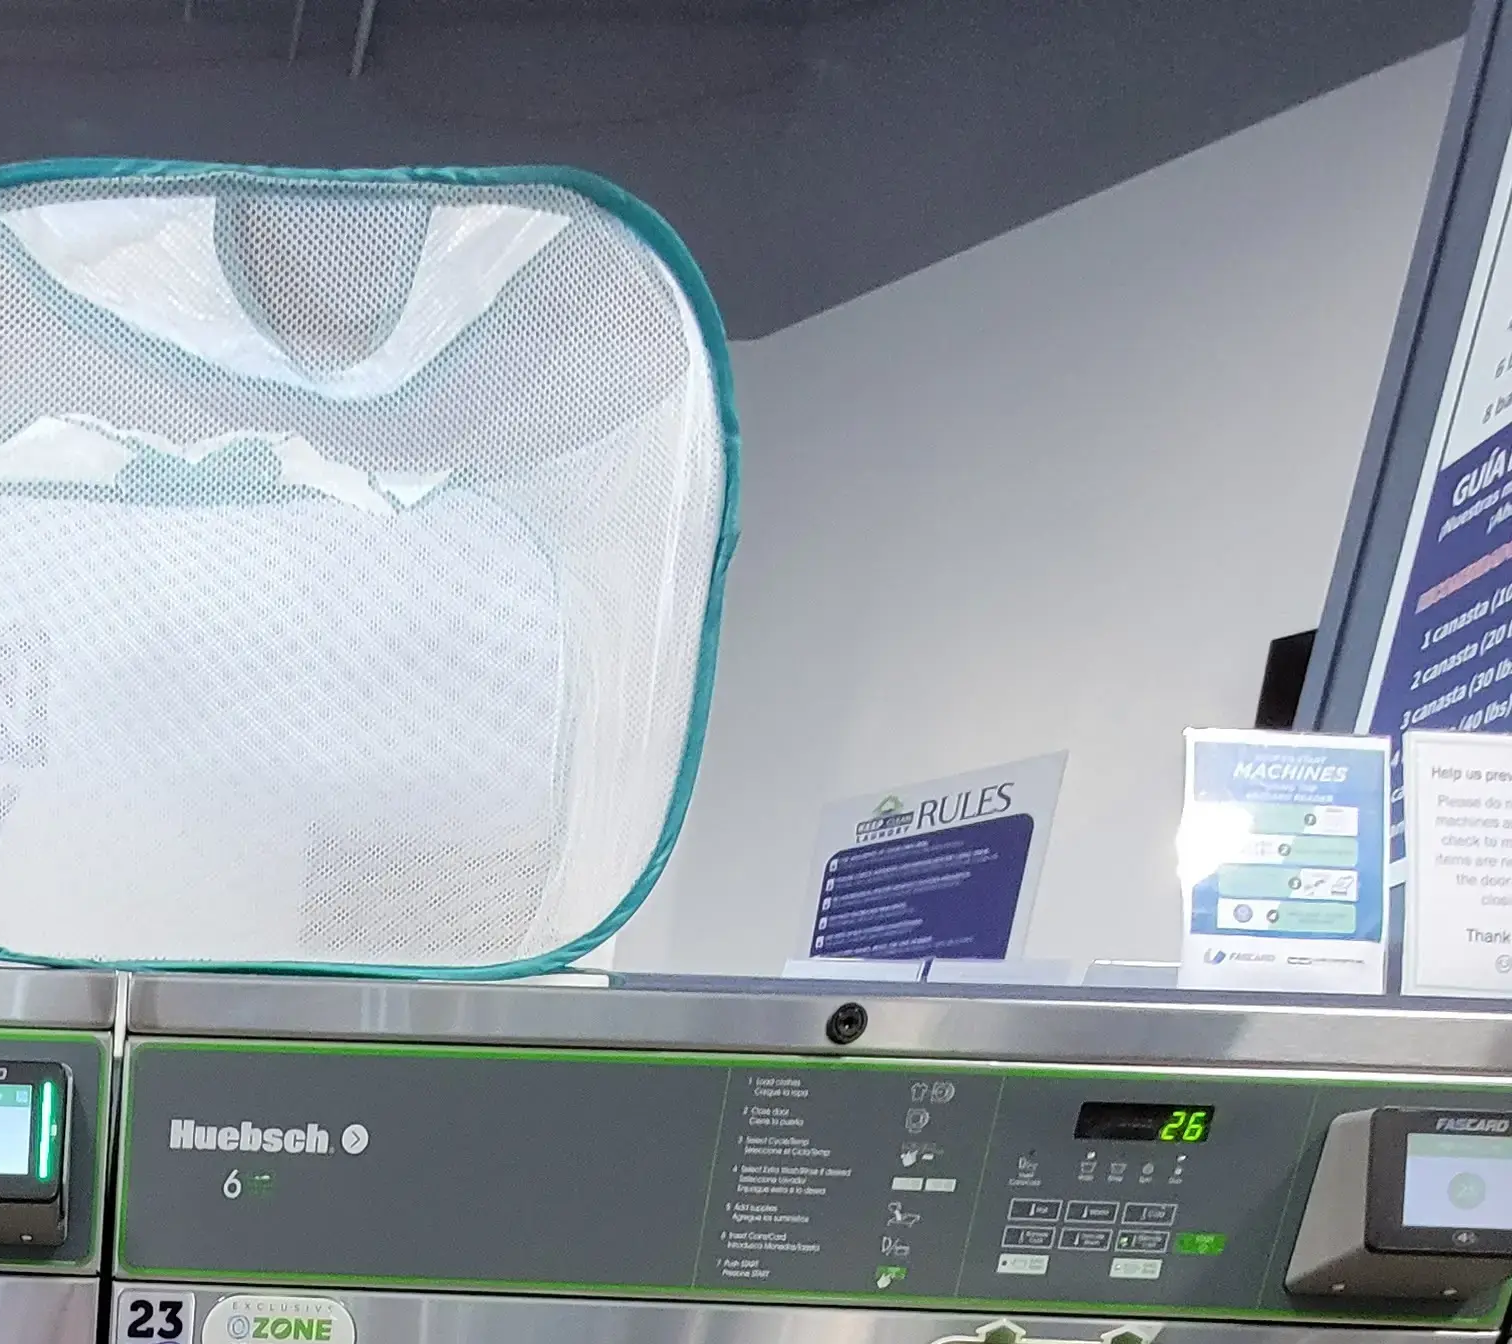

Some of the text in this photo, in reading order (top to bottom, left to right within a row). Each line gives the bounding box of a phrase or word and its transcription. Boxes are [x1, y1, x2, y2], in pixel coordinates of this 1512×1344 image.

[1452, 446, 1506, 507] GUÍA
[1421, 630, 1432, 650] 1
[1432, 600, 1489, 642] canasta
[1410, 629, 1505, 691] 2 canasta (20
[1400, 711, 1411, 730] 3
[1412, 683, 1467, 724] canasta
[1468, 666, 1495, 699] (30
[1233, 762, 1349, 783] MACHINES
[1431, 766, 1462, 781] Help
[1466, 769, 1482, 780] us
[917, 782, 1014, 829] RULES
[1438, 794, 1503, 809] Please do
[1441, 834, 1482, 848] check
[1456, 873, 1478, 886] the
[1466, 928, 1511, 944] Thank
[169, 1119, 330, 1154] Huebsch
[1159, 1111, 1207, 1141] 26
[1436, 1117, 1509, 1132] FASCARD
[127, 1299, 183, 1339] 23
[227, 1314, 333, 1342] OZONE
